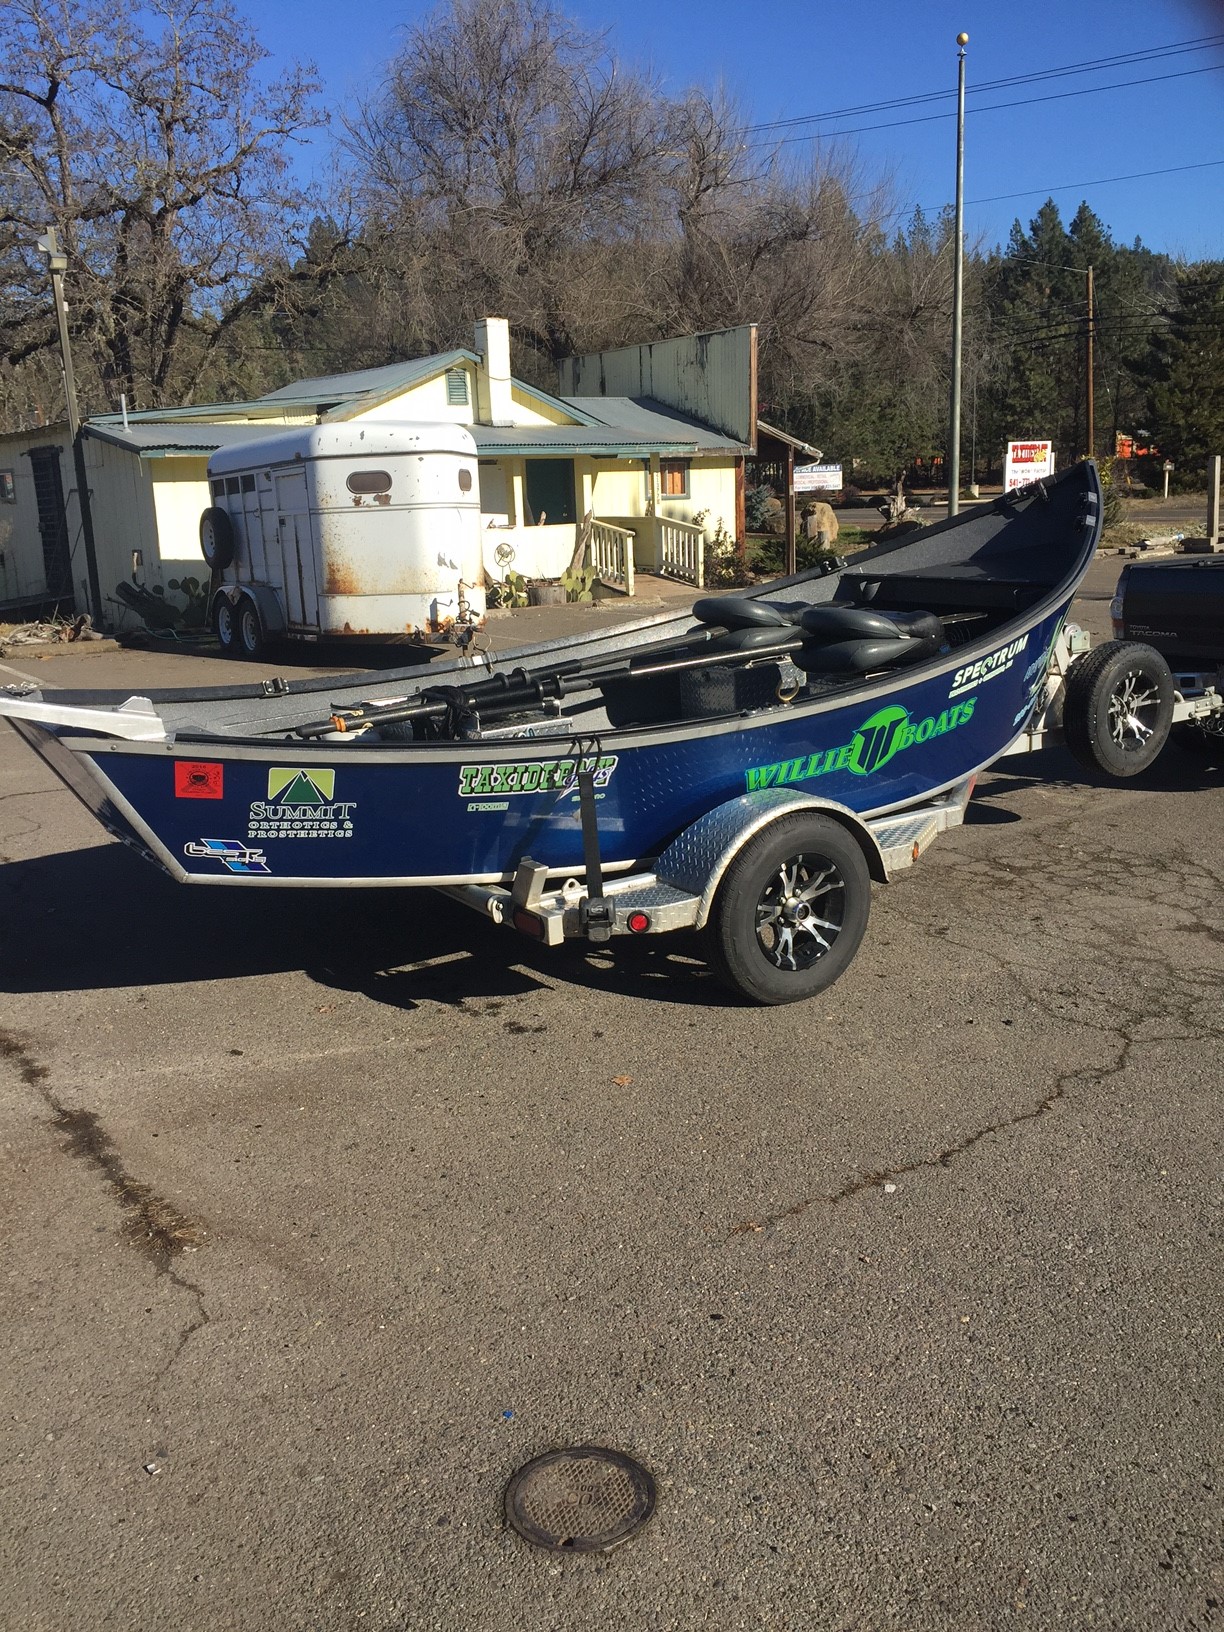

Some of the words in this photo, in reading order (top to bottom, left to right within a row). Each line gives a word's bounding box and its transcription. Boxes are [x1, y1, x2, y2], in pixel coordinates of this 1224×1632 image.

[1130, 630, 1178, 638] TACOMA
[951, 633, 1030, 688] SPECTRUM
[745, 744, 855, 792] WILLIE
[897, 696, 978, 751] BOATS
[249, 801, 357, 820] SUMMIT
[248, 821, 338, 830] ORTHOTICS
[343, 820, 354, 829] &
[247, 830, 353, 838] PROSTHETICS
